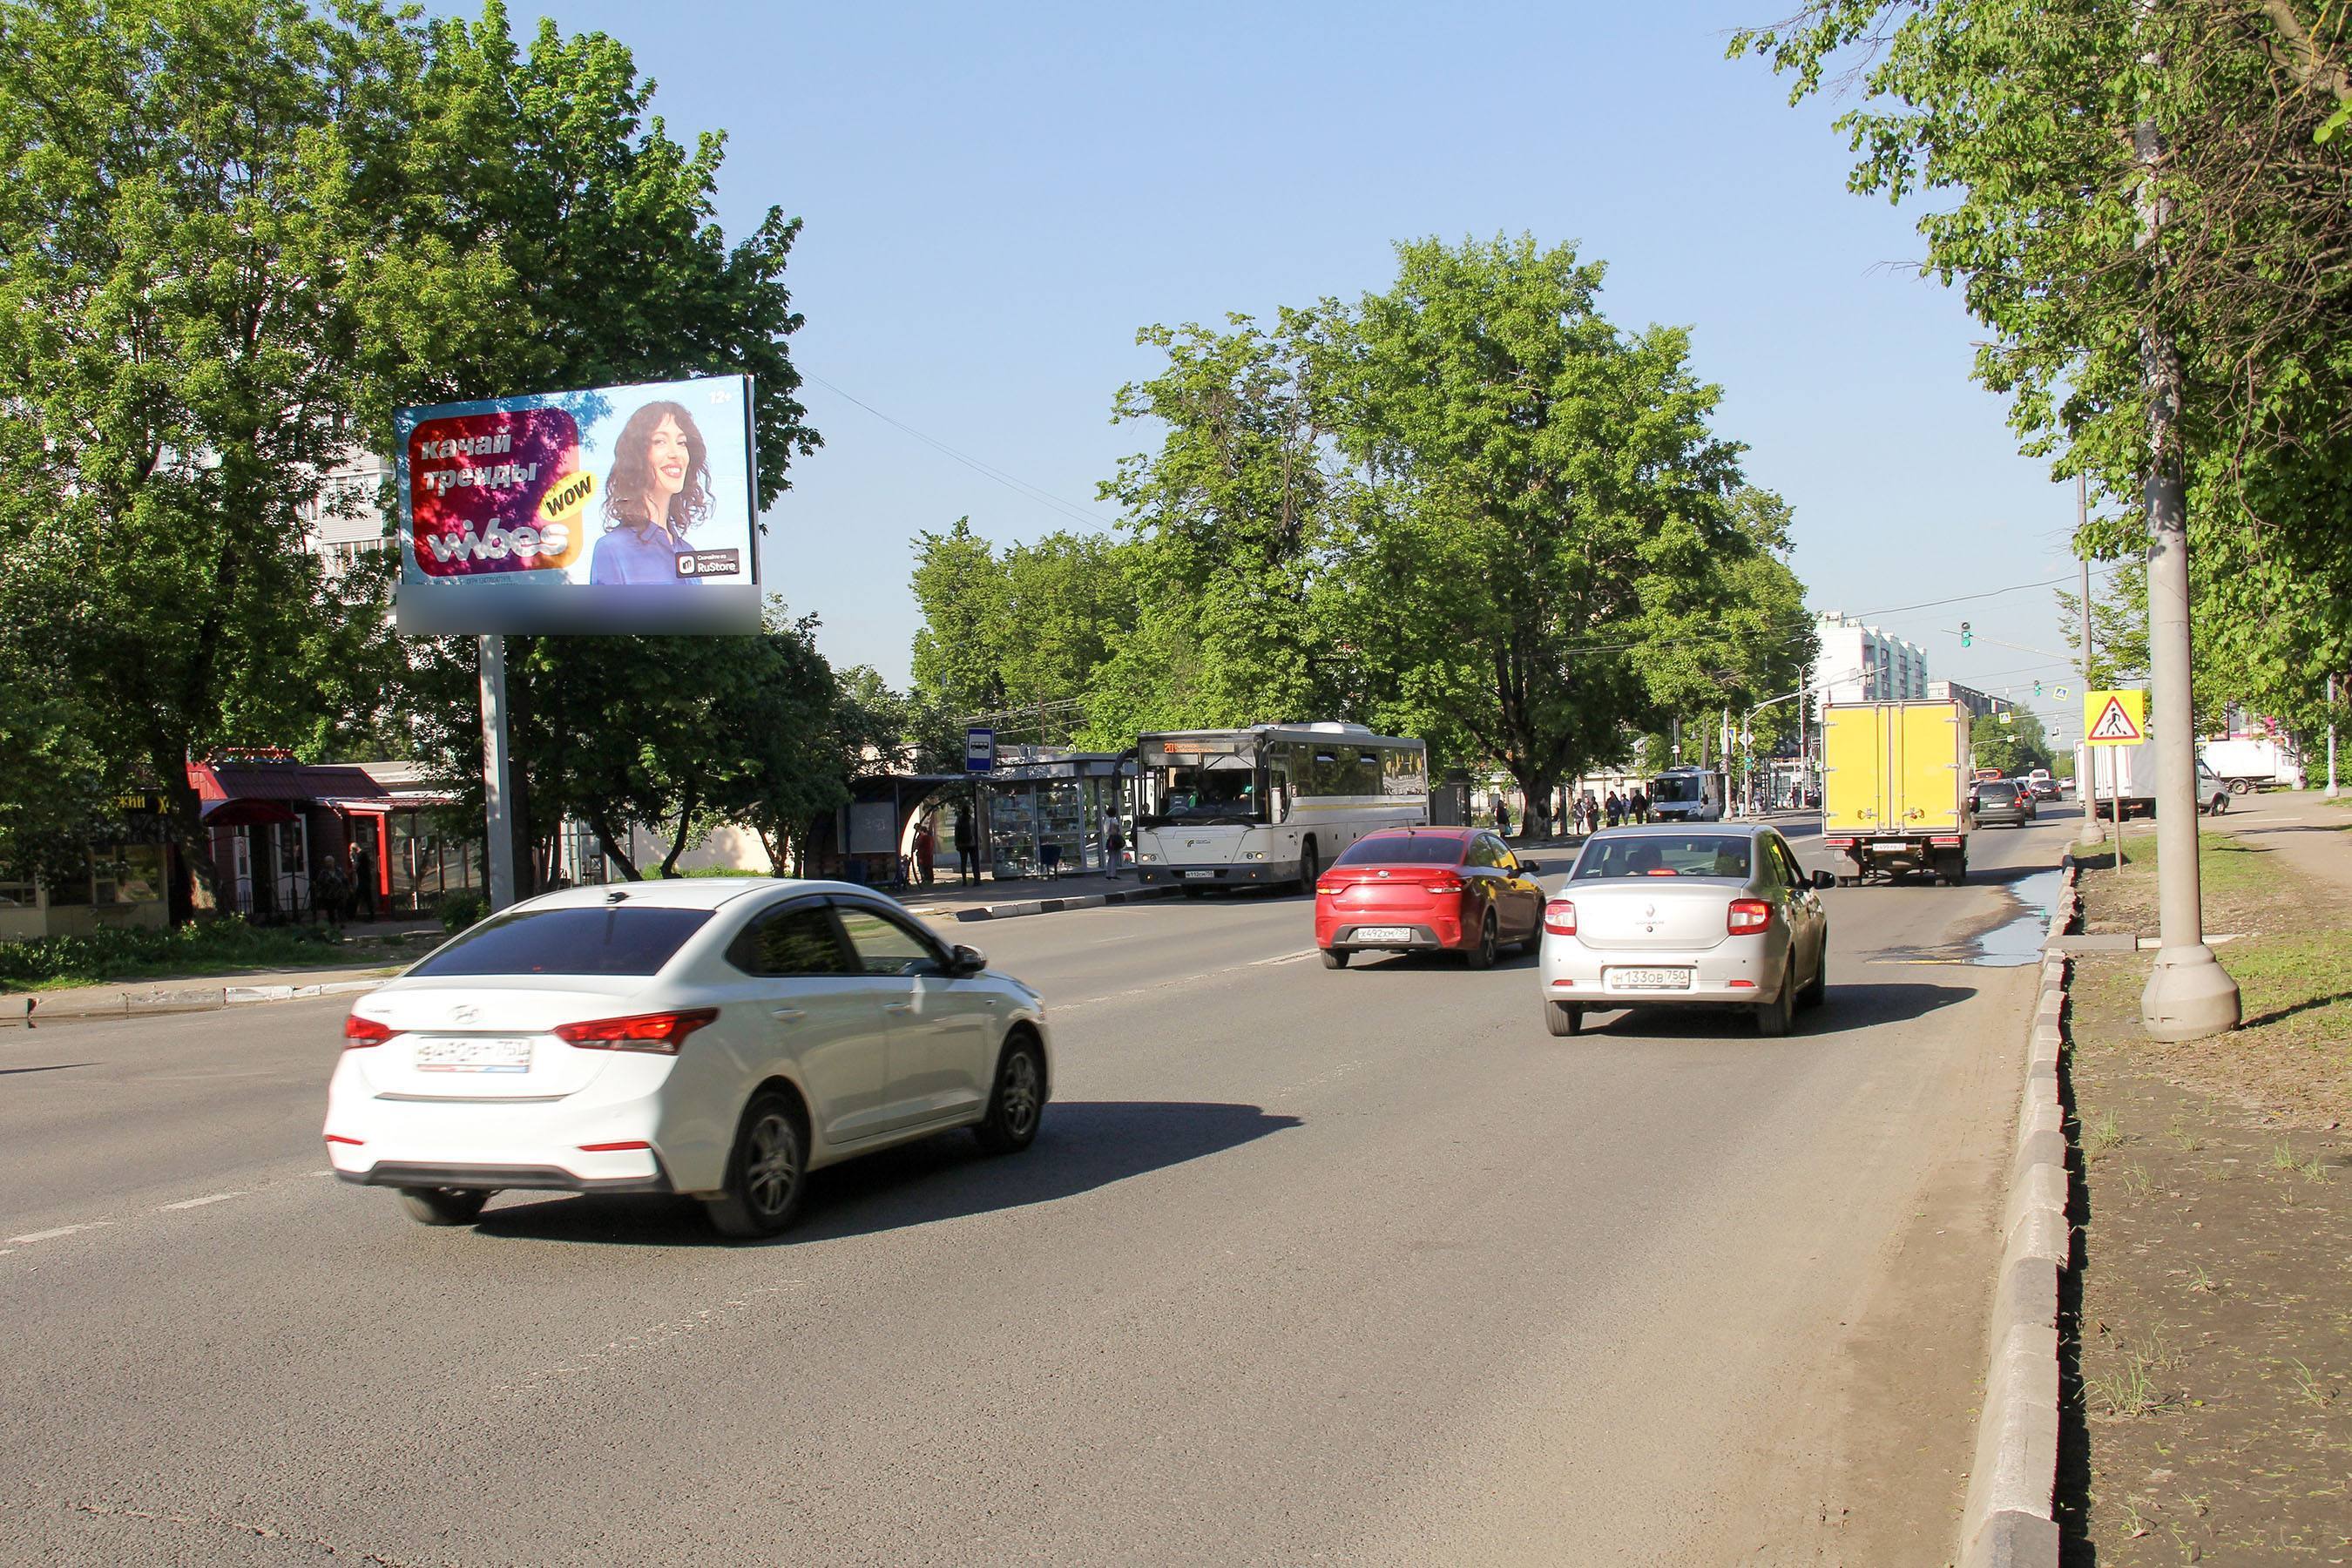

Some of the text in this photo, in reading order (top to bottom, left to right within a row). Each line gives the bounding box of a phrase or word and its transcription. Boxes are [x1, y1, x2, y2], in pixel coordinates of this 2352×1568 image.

[709, 390, 733, 404] 12+
[422, 426, 512, 460] качай
[423, 463, 537, 497] тренды
[697, 562, 737, 573] RuStore
